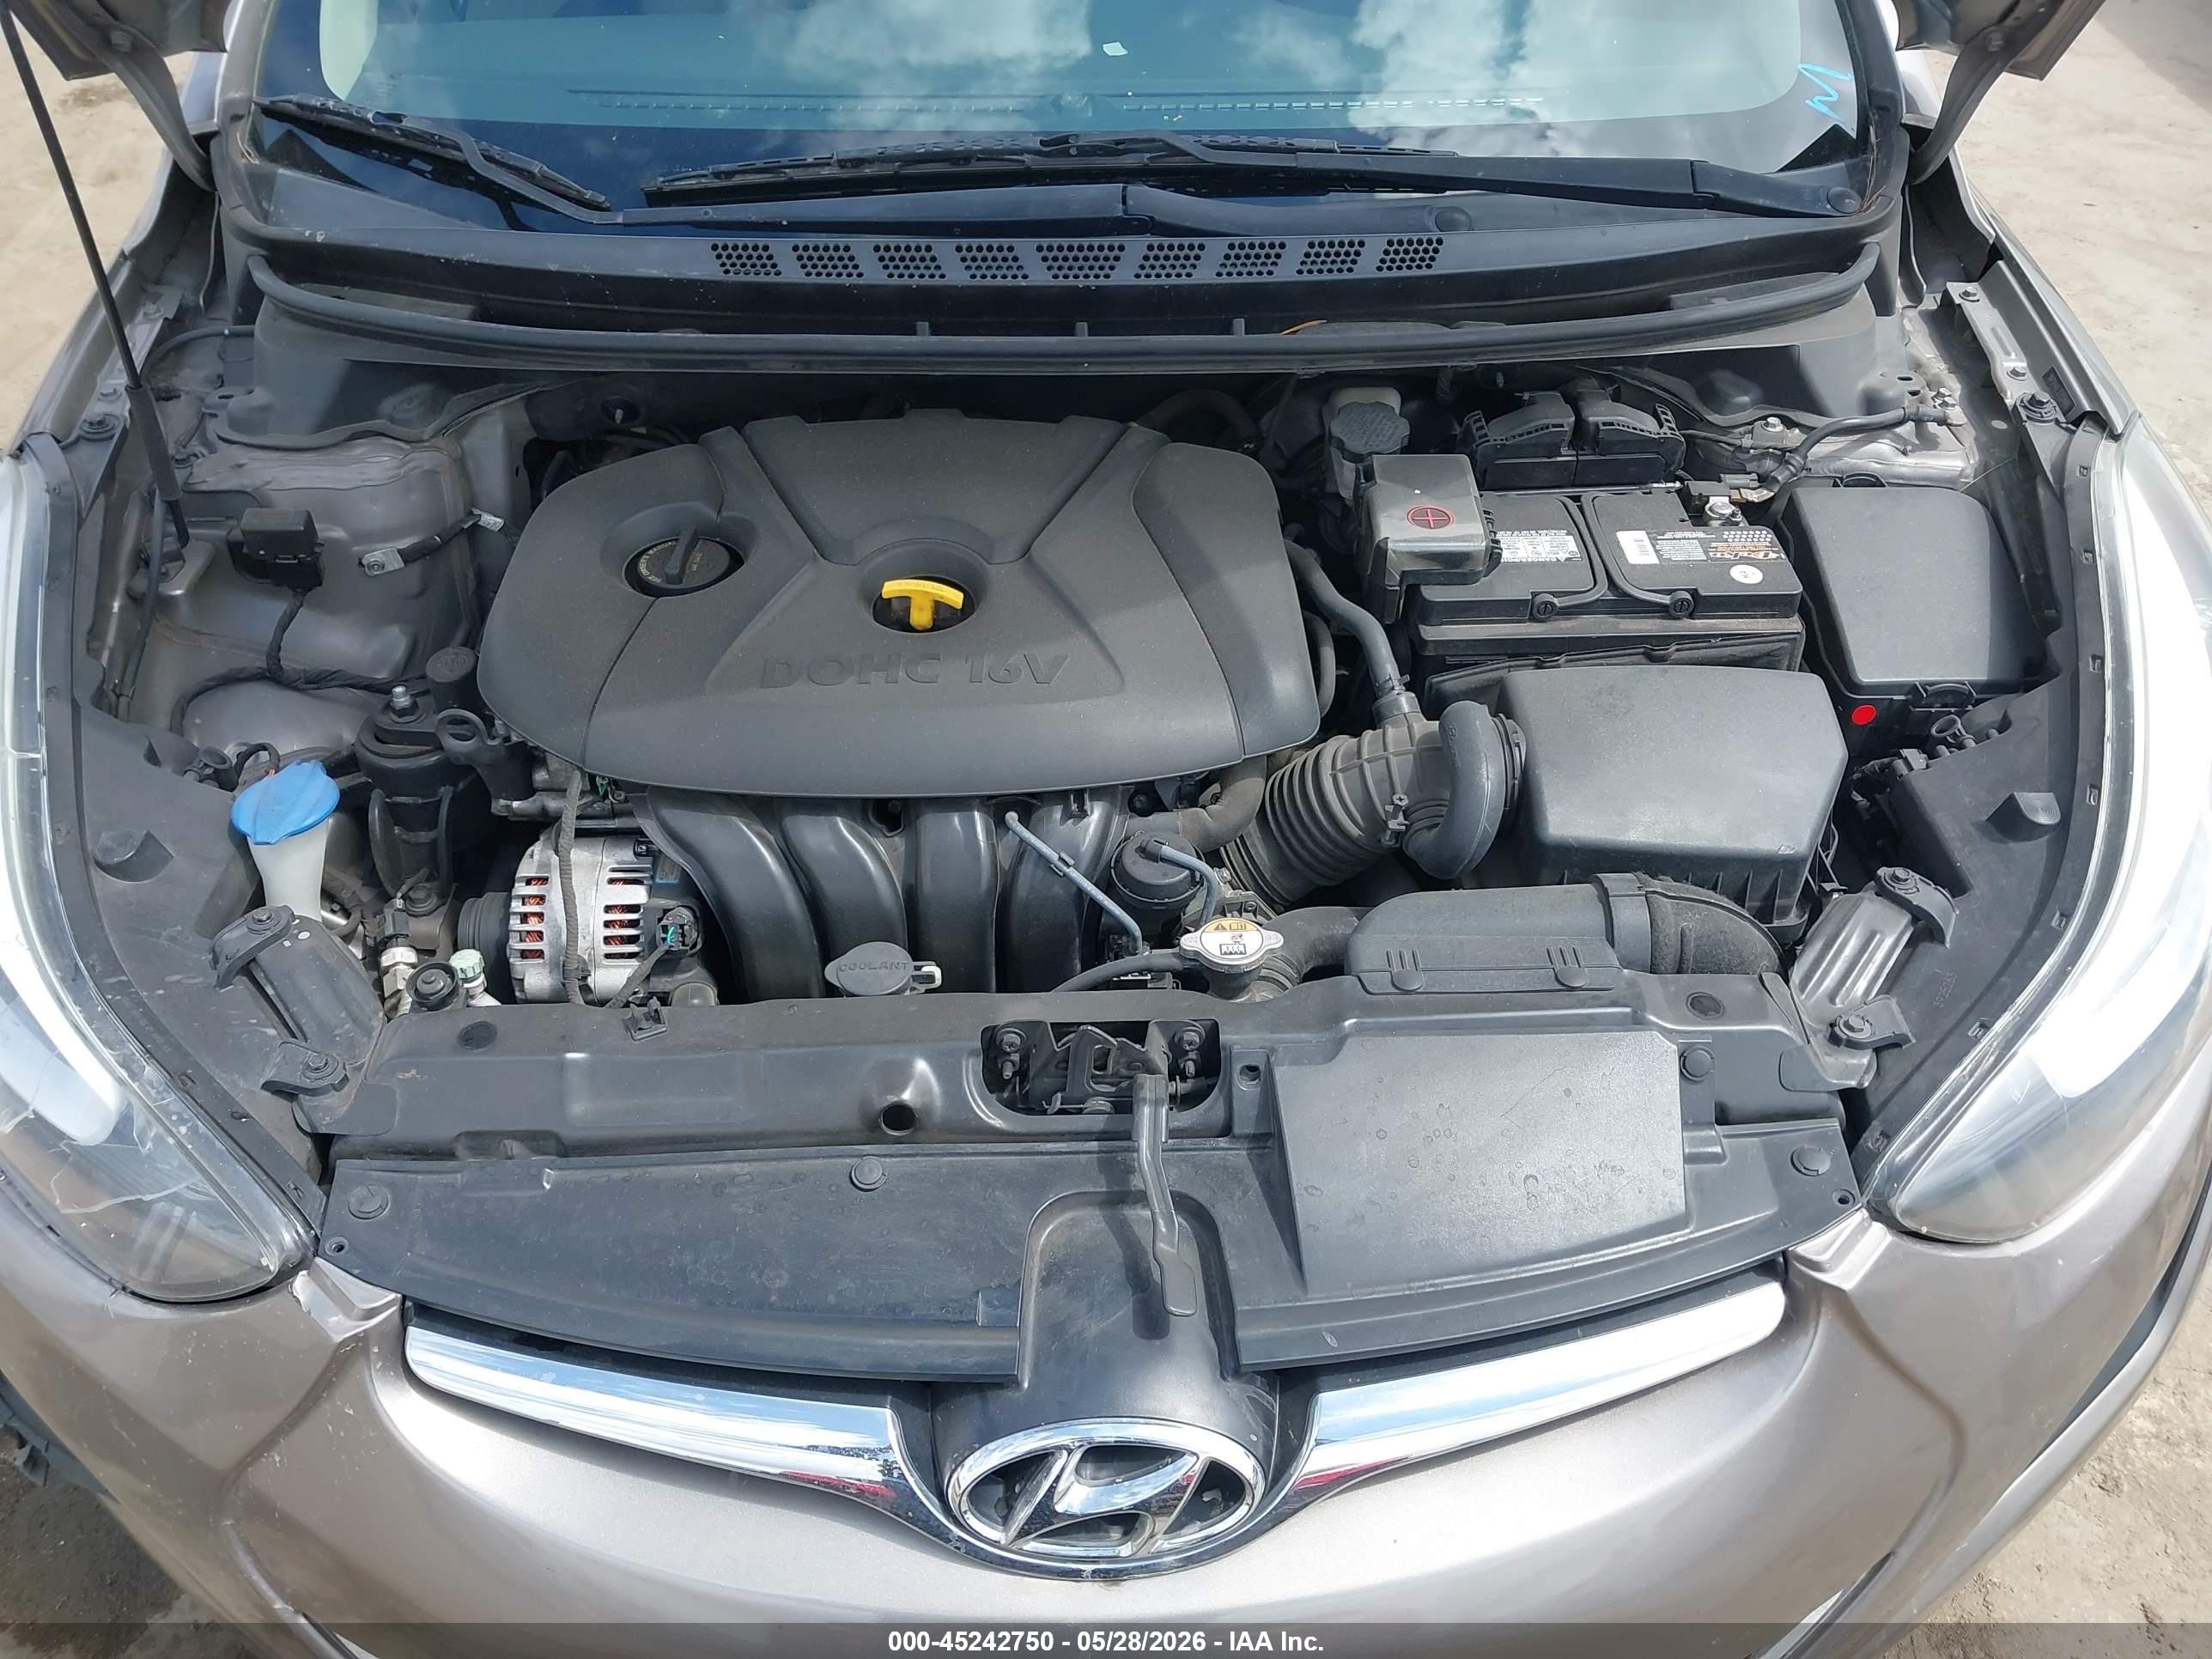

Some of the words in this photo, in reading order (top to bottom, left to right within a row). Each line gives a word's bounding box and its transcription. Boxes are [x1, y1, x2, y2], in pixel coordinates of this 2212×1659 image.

[759, 653, 942, 689] DOHC
[964, 653, 1071, 685] 16V
[839, 961, 910, 973] COOLANT
